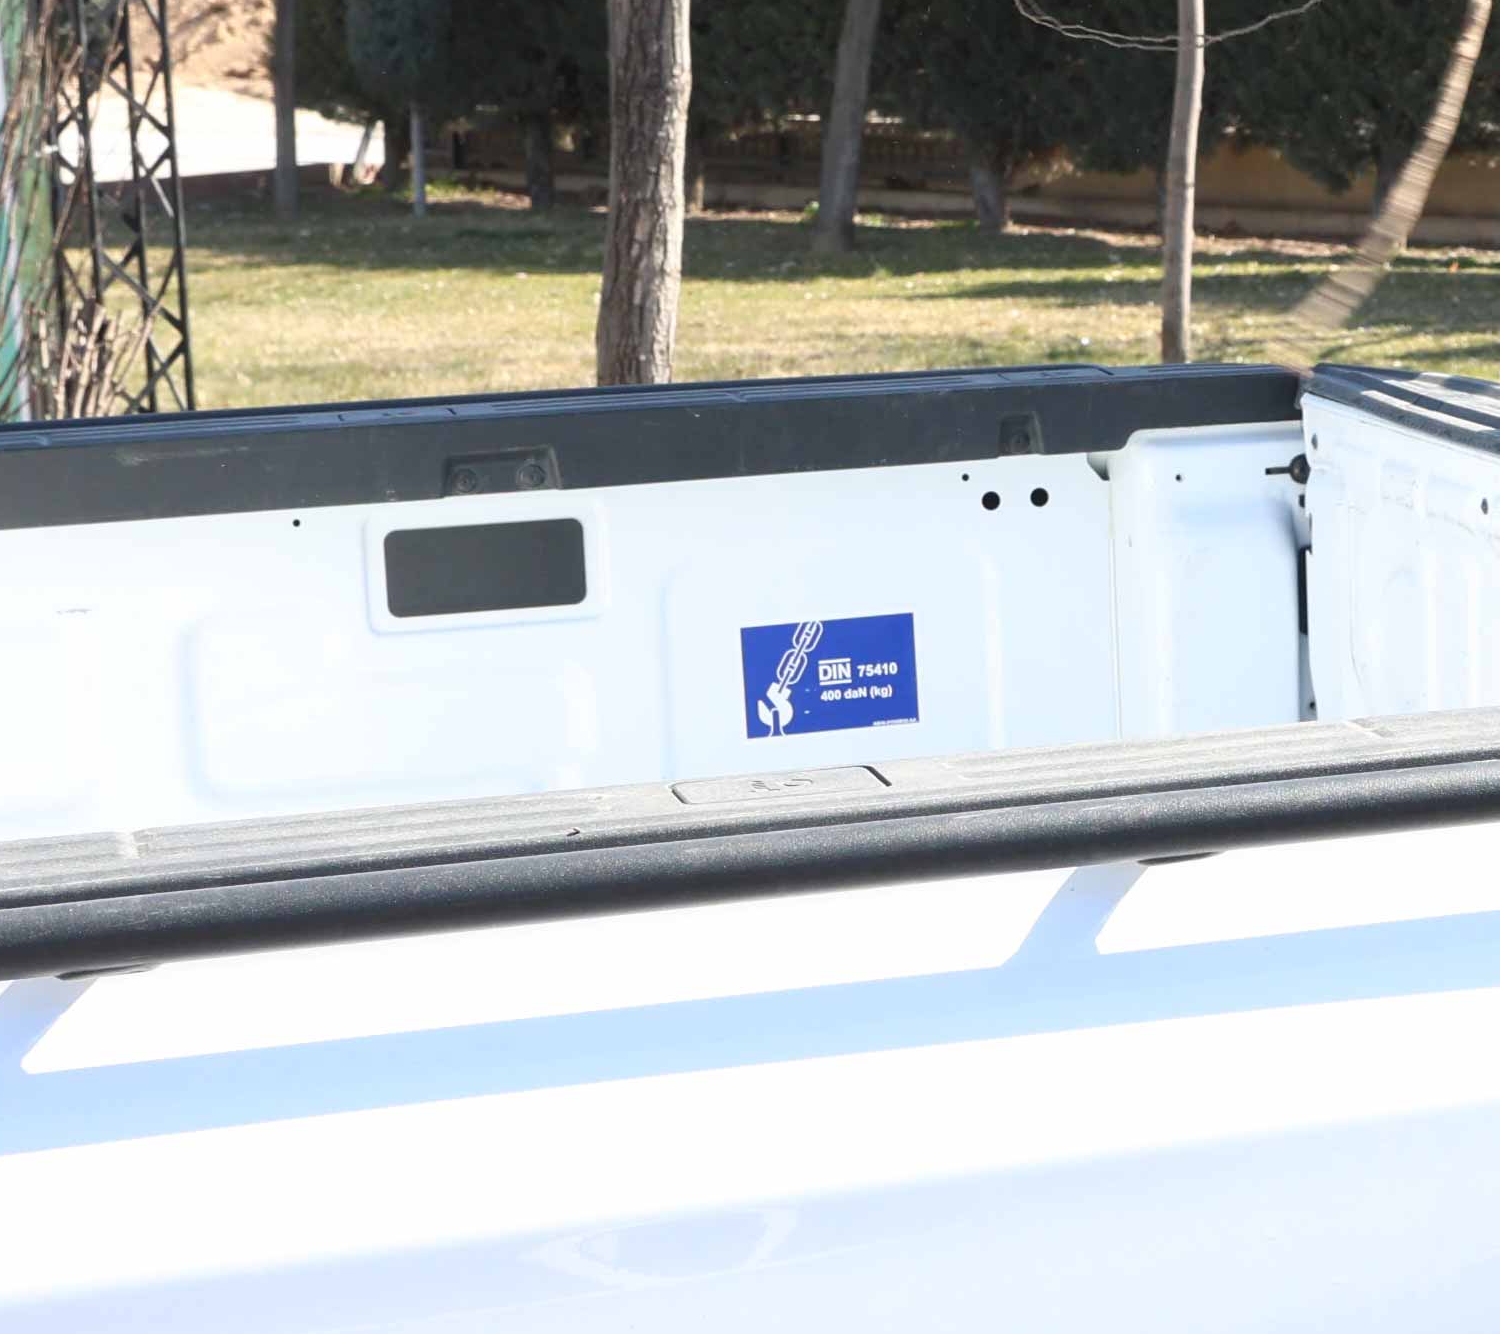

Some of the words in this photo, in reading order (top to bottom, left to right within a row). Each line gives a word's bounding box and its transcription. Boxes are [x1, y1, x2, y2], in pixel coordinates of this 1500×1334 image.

[818, 662, 852, 681] DIN
[857, 661, 898, 678] 75410
[820, 689, 842, 702] 400
[844, 686, 867, 700] daN
[870, 684, 893, 700] (kg)
